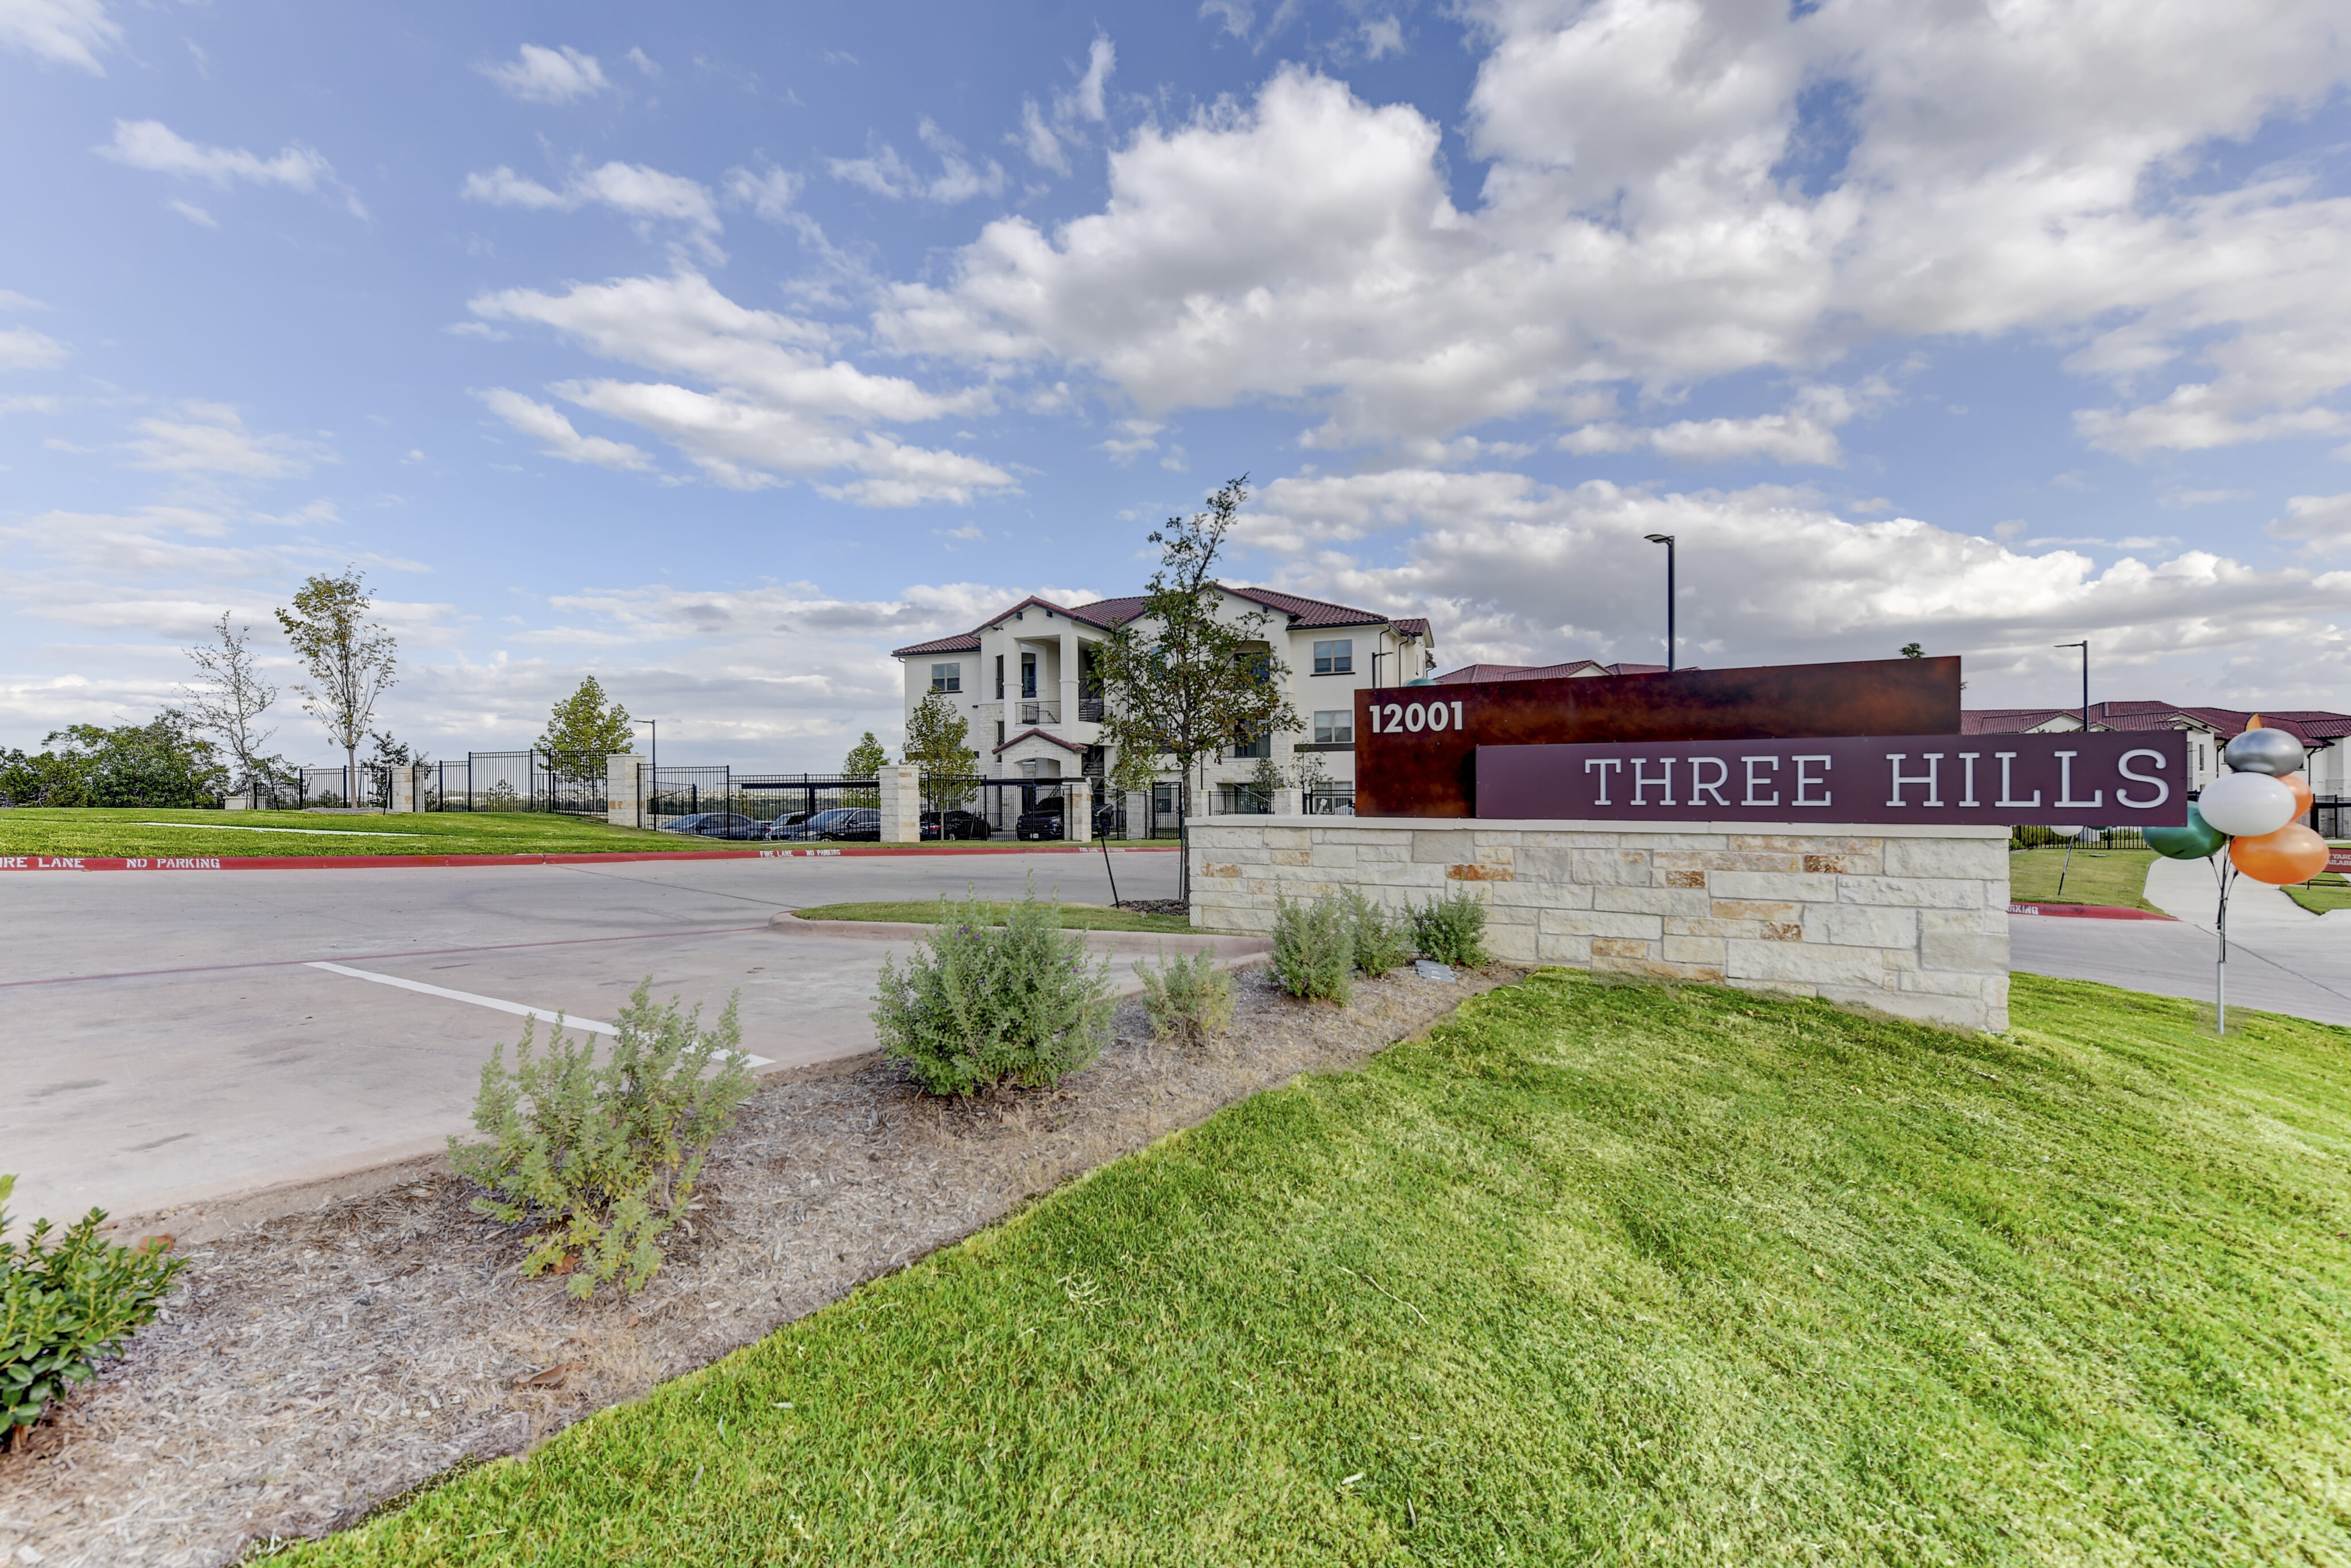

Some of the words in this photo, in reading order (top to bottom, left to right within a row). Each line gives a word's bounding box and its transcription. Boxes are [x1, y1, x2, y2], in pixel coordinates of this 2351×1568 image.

[1369, 701, 1463, 733] 12001
[1585, 755, 1832, 806] THREE
[1886, 748, 2169, 809] HILLS
[38, 857, 85, 868] LANE
[126, 859, 148, 868] NO
[157, 859, 220, 868] PARKING
